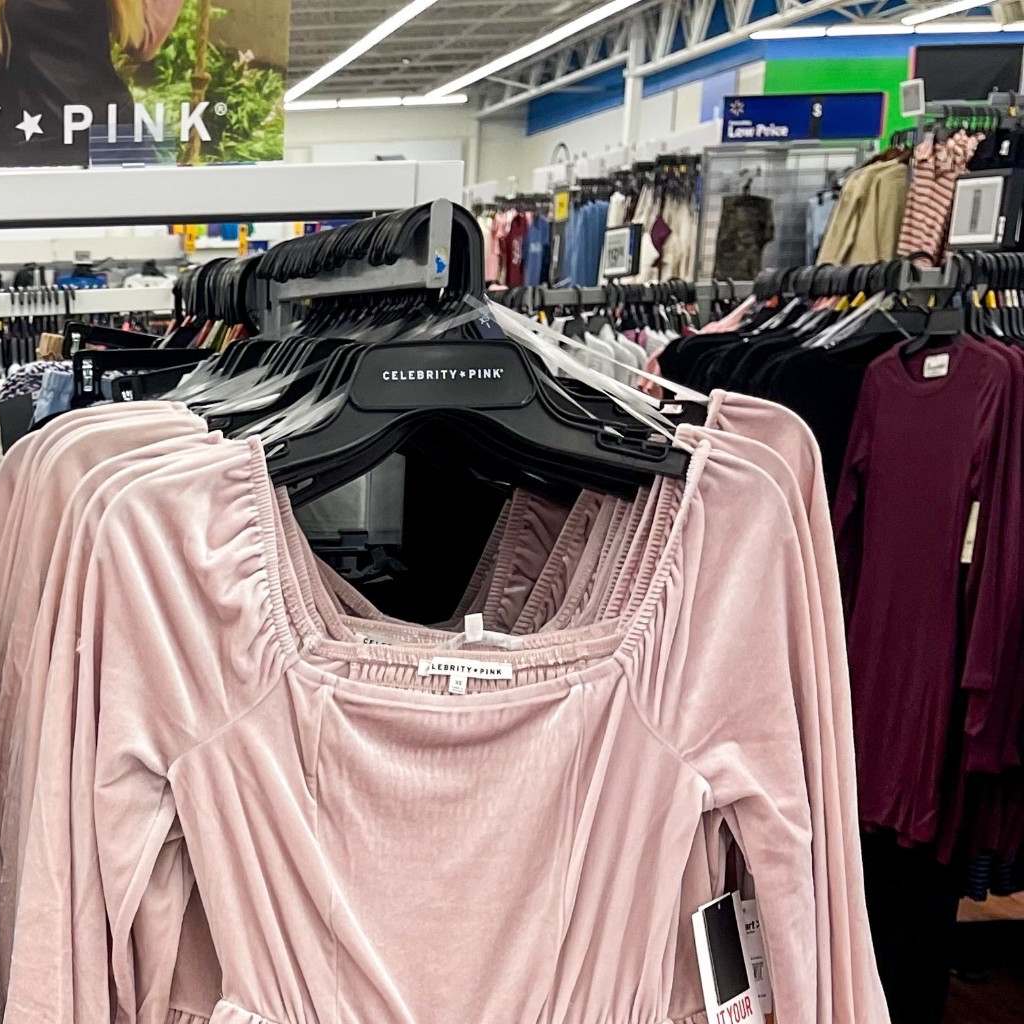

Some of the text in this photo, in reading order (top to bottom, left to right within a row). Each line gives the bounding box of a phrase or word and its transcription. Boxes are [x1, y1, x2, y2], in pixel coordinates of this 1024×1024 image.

[727, 123, 789, 138] Low Price
[382, 369, 457, 381] CELEBRITY
[431, 663, 472, 673] LEBRITY
